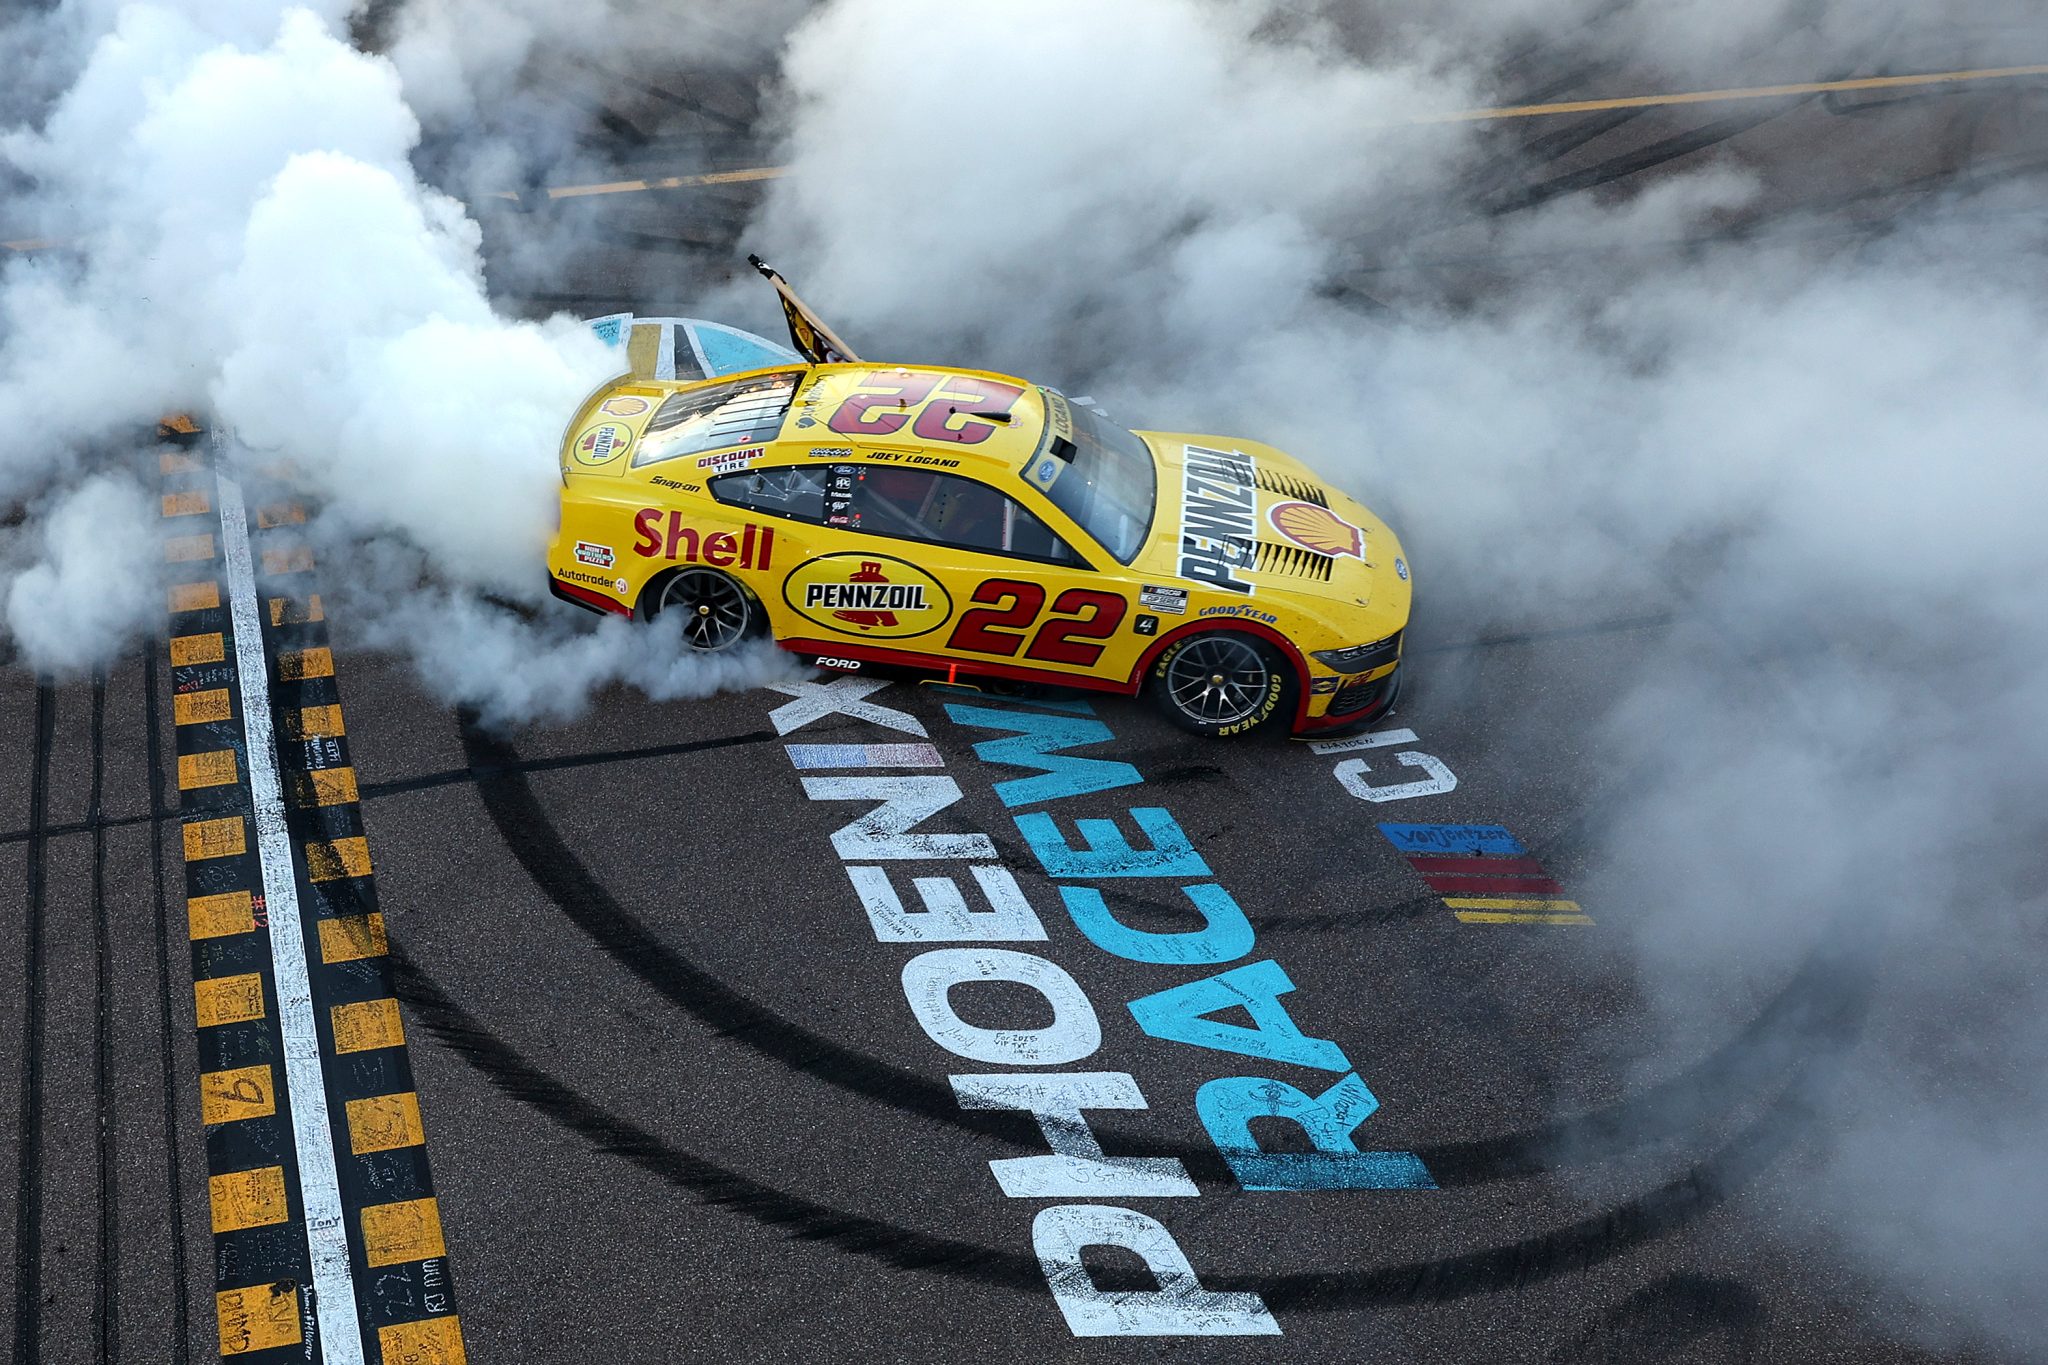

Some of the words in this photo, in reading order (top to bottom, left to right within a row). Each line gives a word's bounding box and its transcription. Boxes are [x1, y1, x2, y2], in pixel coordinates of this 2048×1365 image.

[828, 372, 1026, 444] 22
[1052, 398, 1069, 434] LOGANO
[591, 427, 616, 460] PENNZOIL
[697, 448, 765, 468] DISCOUNT
[716, 461, 746, 472] TIRE
[866, 452, 903, 464] JOEY
[904, 455, 960, 468] LOGANO
[650, 475, 701, 493] Snap-on
[1180, 445, 1255, 595] PENNZOIL
[633, 508, 775, 571] Shell
[584, 556, 604, 565] PIZZA
[558, 567, 614, 588] Autotrader
[806, 584, 929, 611] PENNZOIL
[1155, 588, 1182, 596] NASCAR
[945, 577, 1128, 667] 22
[1199, 604, 1278, 624] GOODYEAR
[815, 656, 861, 670] FORD
[1156, 641, 1184, 678] EAGLE
[1217, 673, 1282, 736] GOODYEAR
[762, 676, 1282, 1337] PHOENIX
